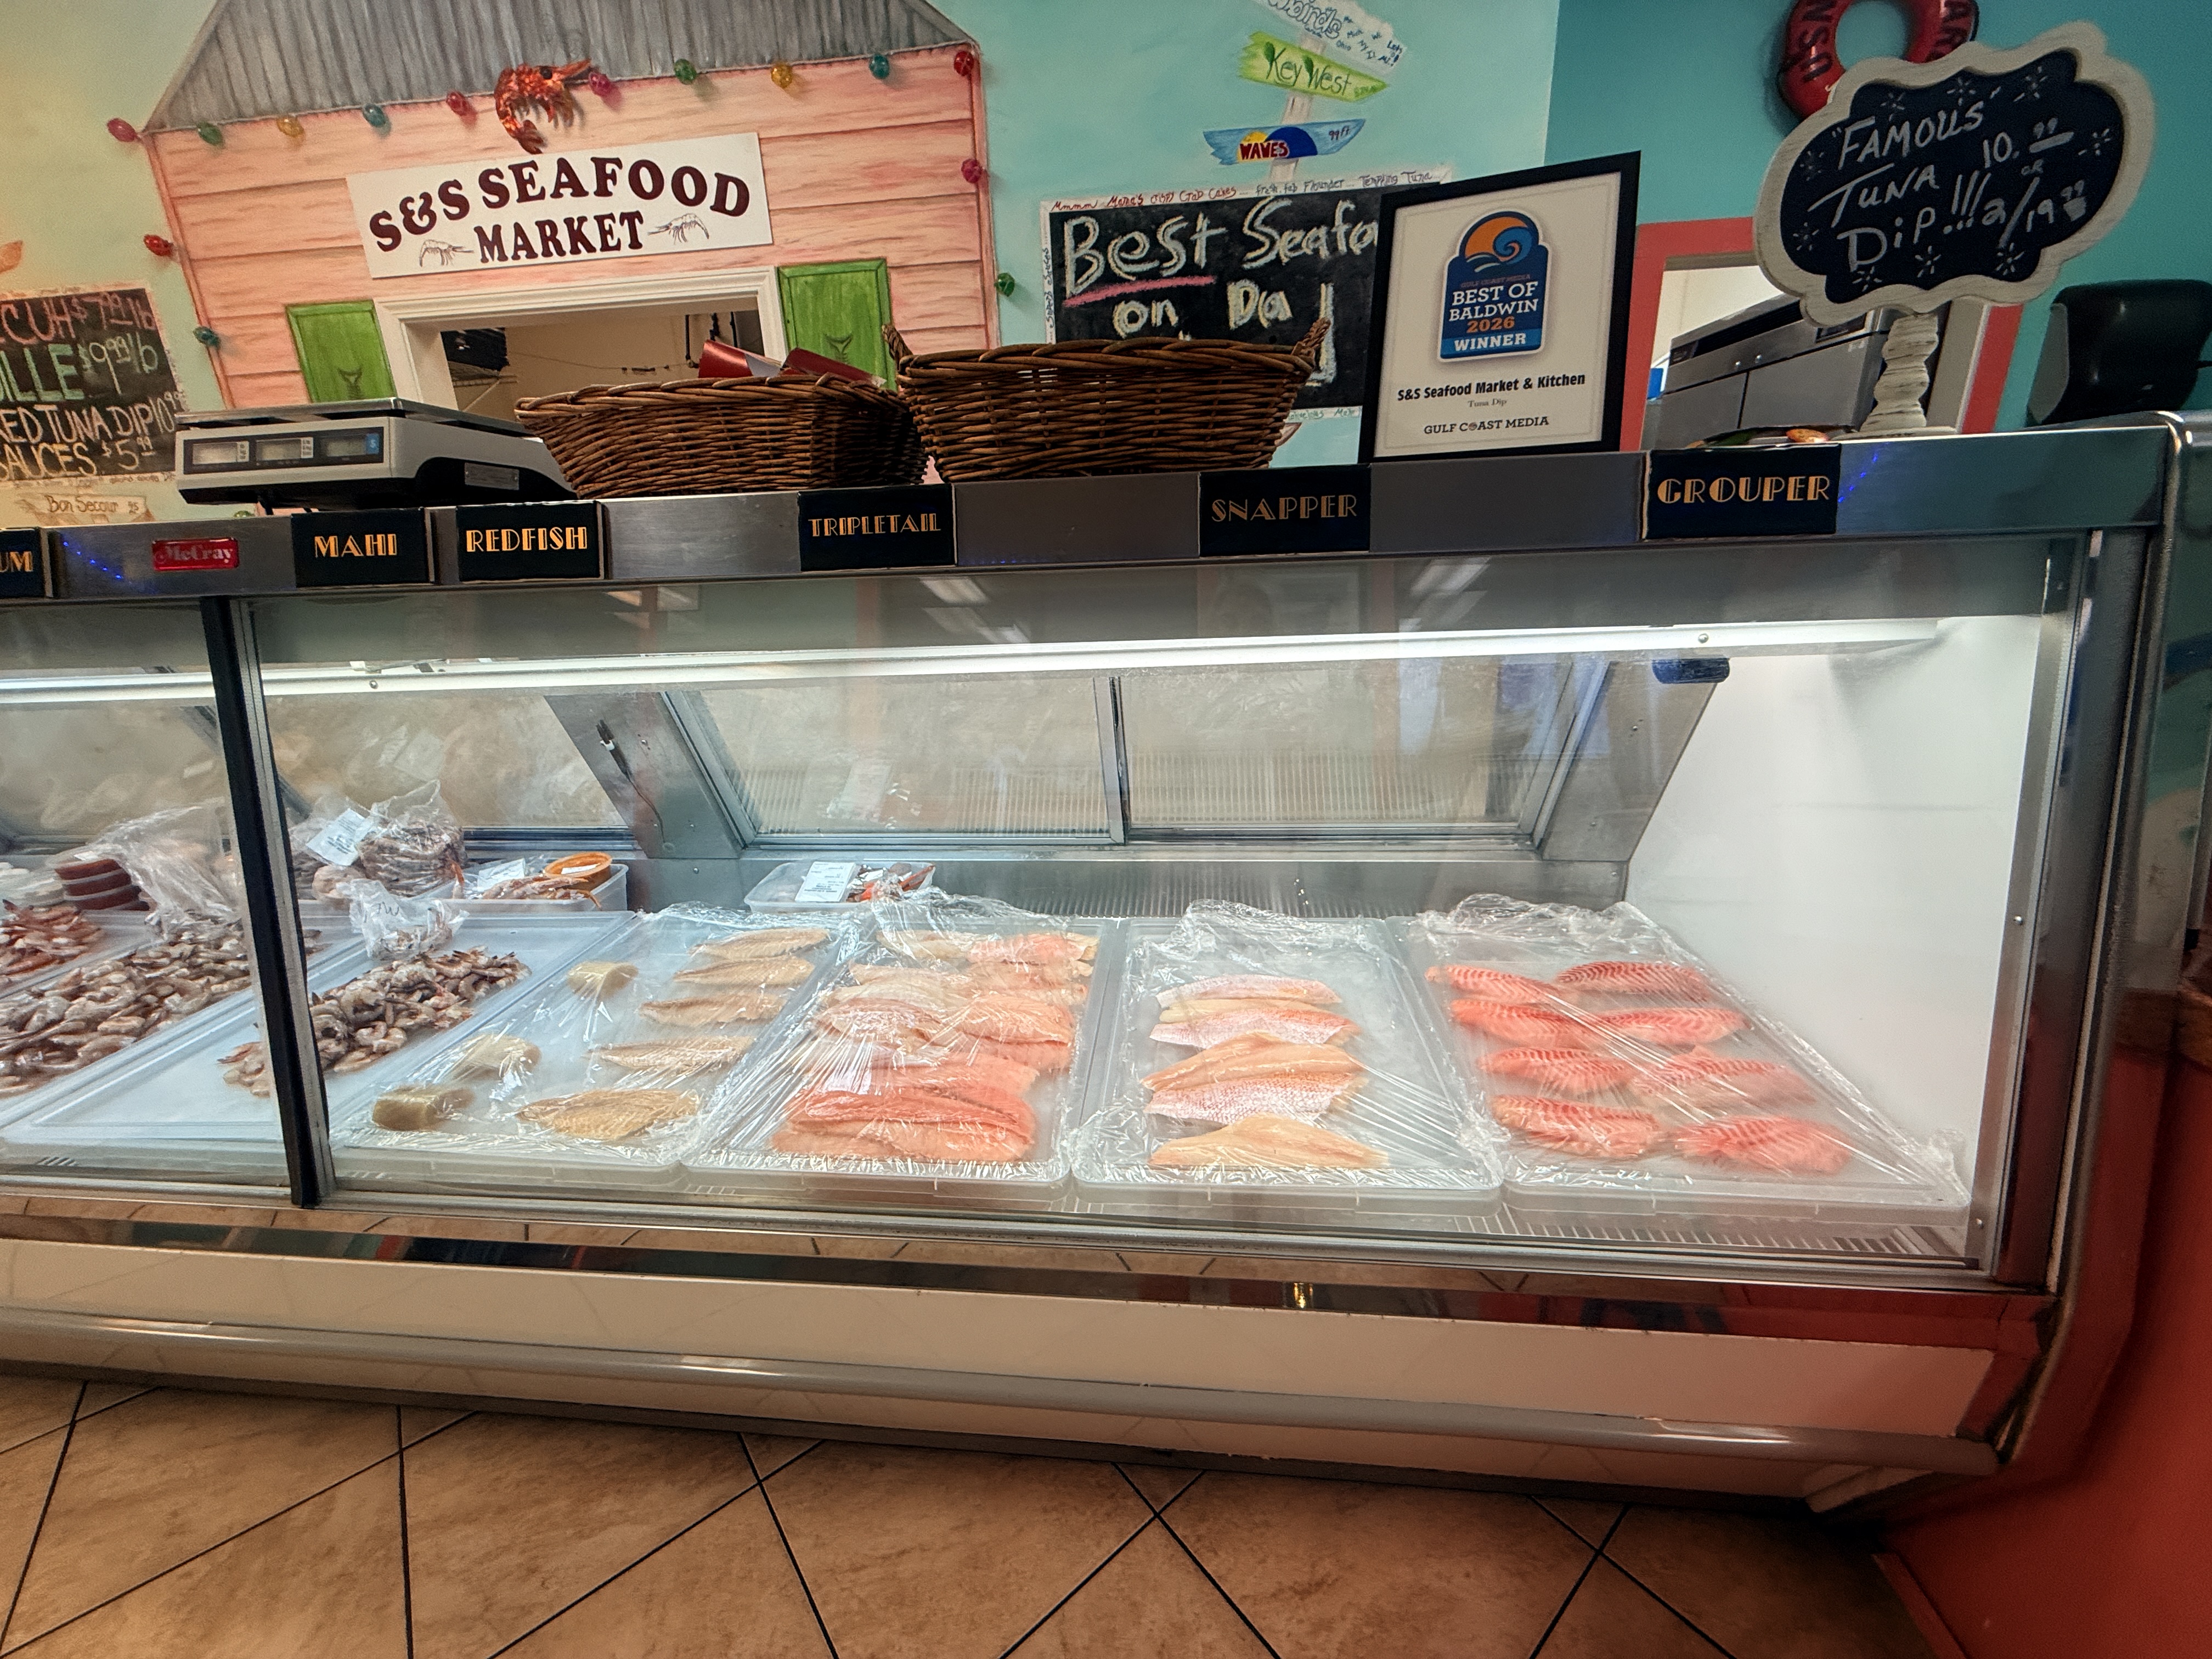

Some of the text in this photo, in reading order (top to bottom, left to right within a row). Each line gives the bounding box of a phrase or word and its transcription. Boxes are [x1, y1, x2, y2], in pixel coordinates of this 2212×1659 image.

[1264, 42, 1352, 95] Key West
[1239, 141, 1289, 160] WAVES
[1401, 170, 1432, 183] Tuna
[369, 157, 750, 252] S&S SEAFOOD
[473, 210, 644, 263] MARKET
[1063, 211, 1228, 300] Best
[1452, 281, 1538, 306] BEST OF
[0, 298, 76, 345] CUH
[1113, 279, 1293, 338] on Da
[1449, 298, 1539, 321] BALDWIN
[1466, 315, 1515, 334] 2026
[1454, 332, 1527, 352] WINNER
[1397, 374, 1586, 401] S&S Seafood Market & Kitchen
[1468, 398, 1508, 408] Tuna Dip
[33, 403, 113, 443] TUNA
[106, 402, 155, 438] DIP
[1424, 416, 1550, 435] GULF COAST MEDIA
[1657, 475, 1831, 504] GROUPER
[1211, 494, 1358, 522] SNAPPER
[808, 512, 941, 538] TRIPLETAIL
[314, 533, 398, 559] MAHI
[465, 526, 588, 553] REDFISH
